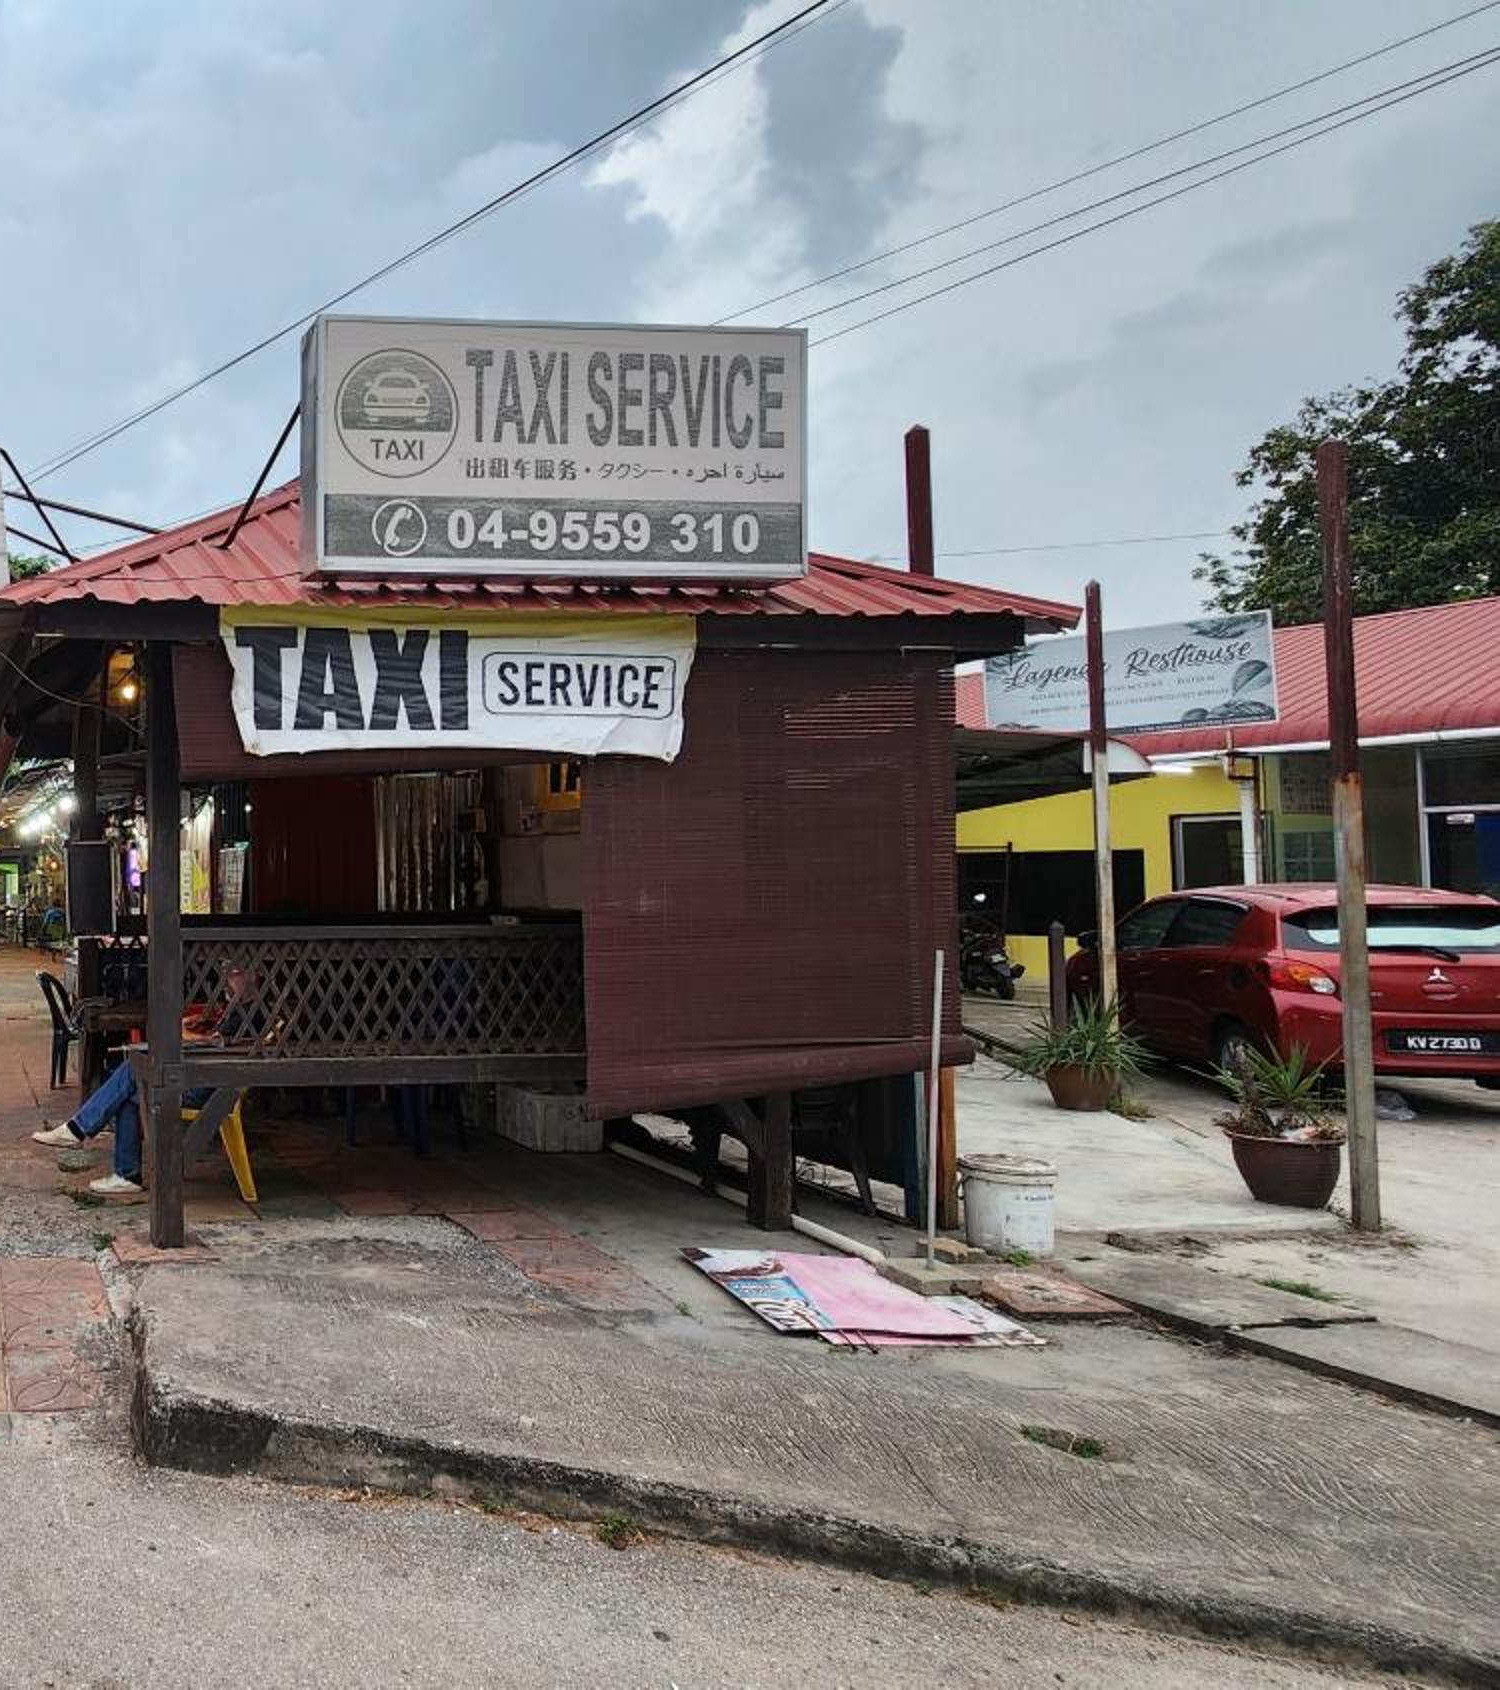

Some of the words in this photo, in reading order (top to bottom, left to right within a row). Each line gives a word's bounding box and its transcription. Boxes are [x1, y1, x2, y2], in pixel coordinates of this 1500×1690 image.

[465, 350, 569, 445] TAXI
[586, 352, 786, 450] SERVICE
[370, 438, 425, 461] TAXI
[465, 457, 577, 481] 出租车服务
[446, 508, 652, 554] 04-9559
[670, 512, 761, 555] 310
[235, 626, 470, 731] TAXI
[497, 661, 665, 710] SERVICE
